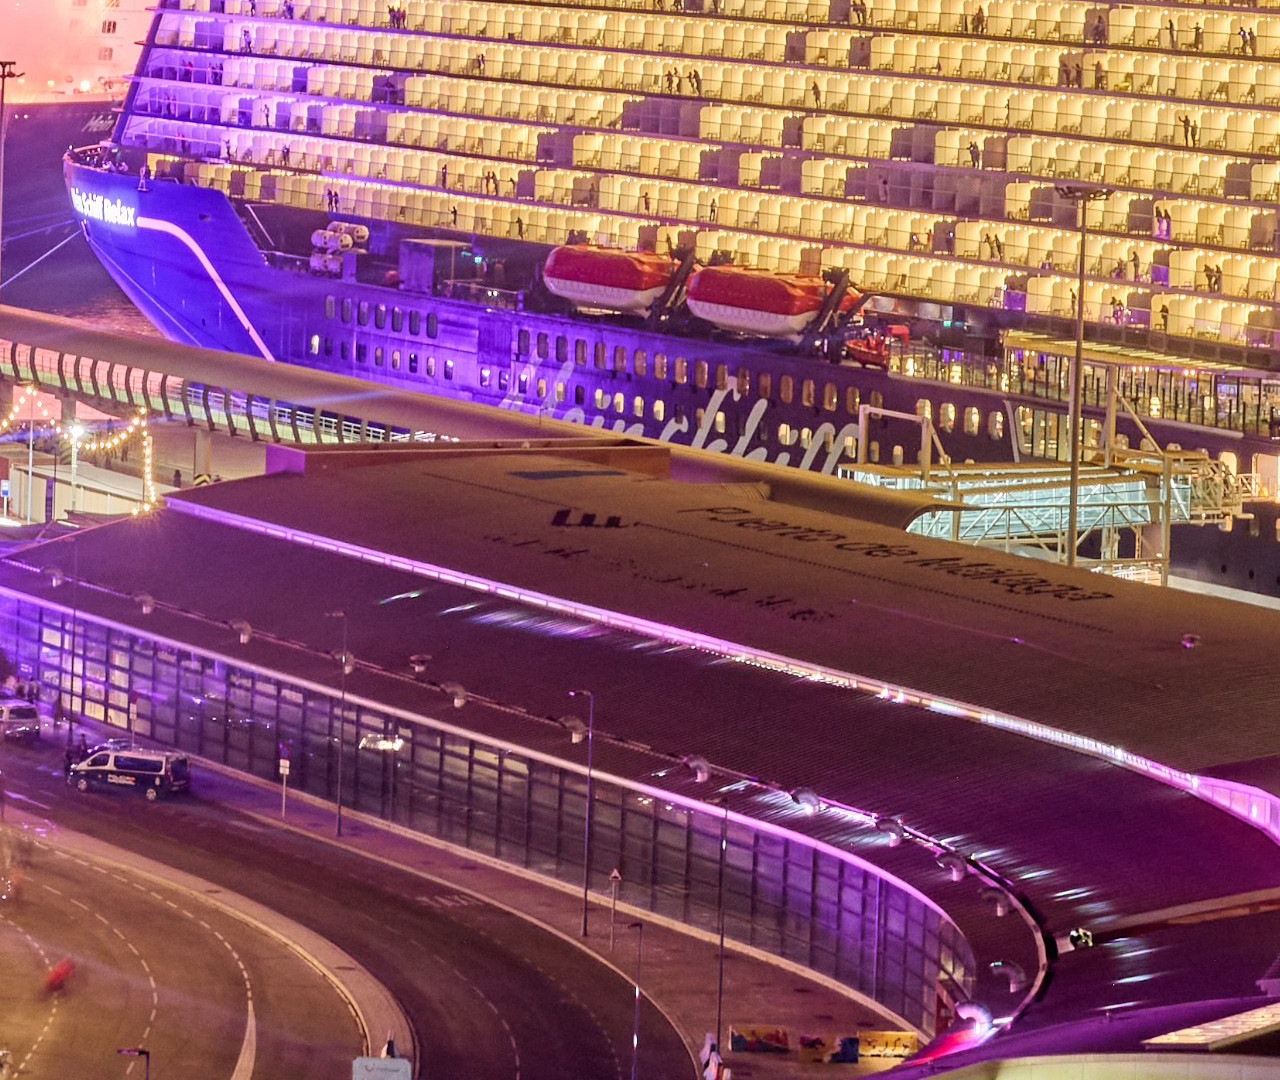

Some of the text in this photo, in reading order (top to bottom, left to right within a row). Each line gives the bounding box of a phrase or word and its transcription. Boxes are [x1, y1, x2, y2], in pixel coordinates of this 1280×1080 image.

[81, 114, 115, 133] Mein
[82, 191, 104, 221] Schiff
[104, 198, 135, 227] Relax
